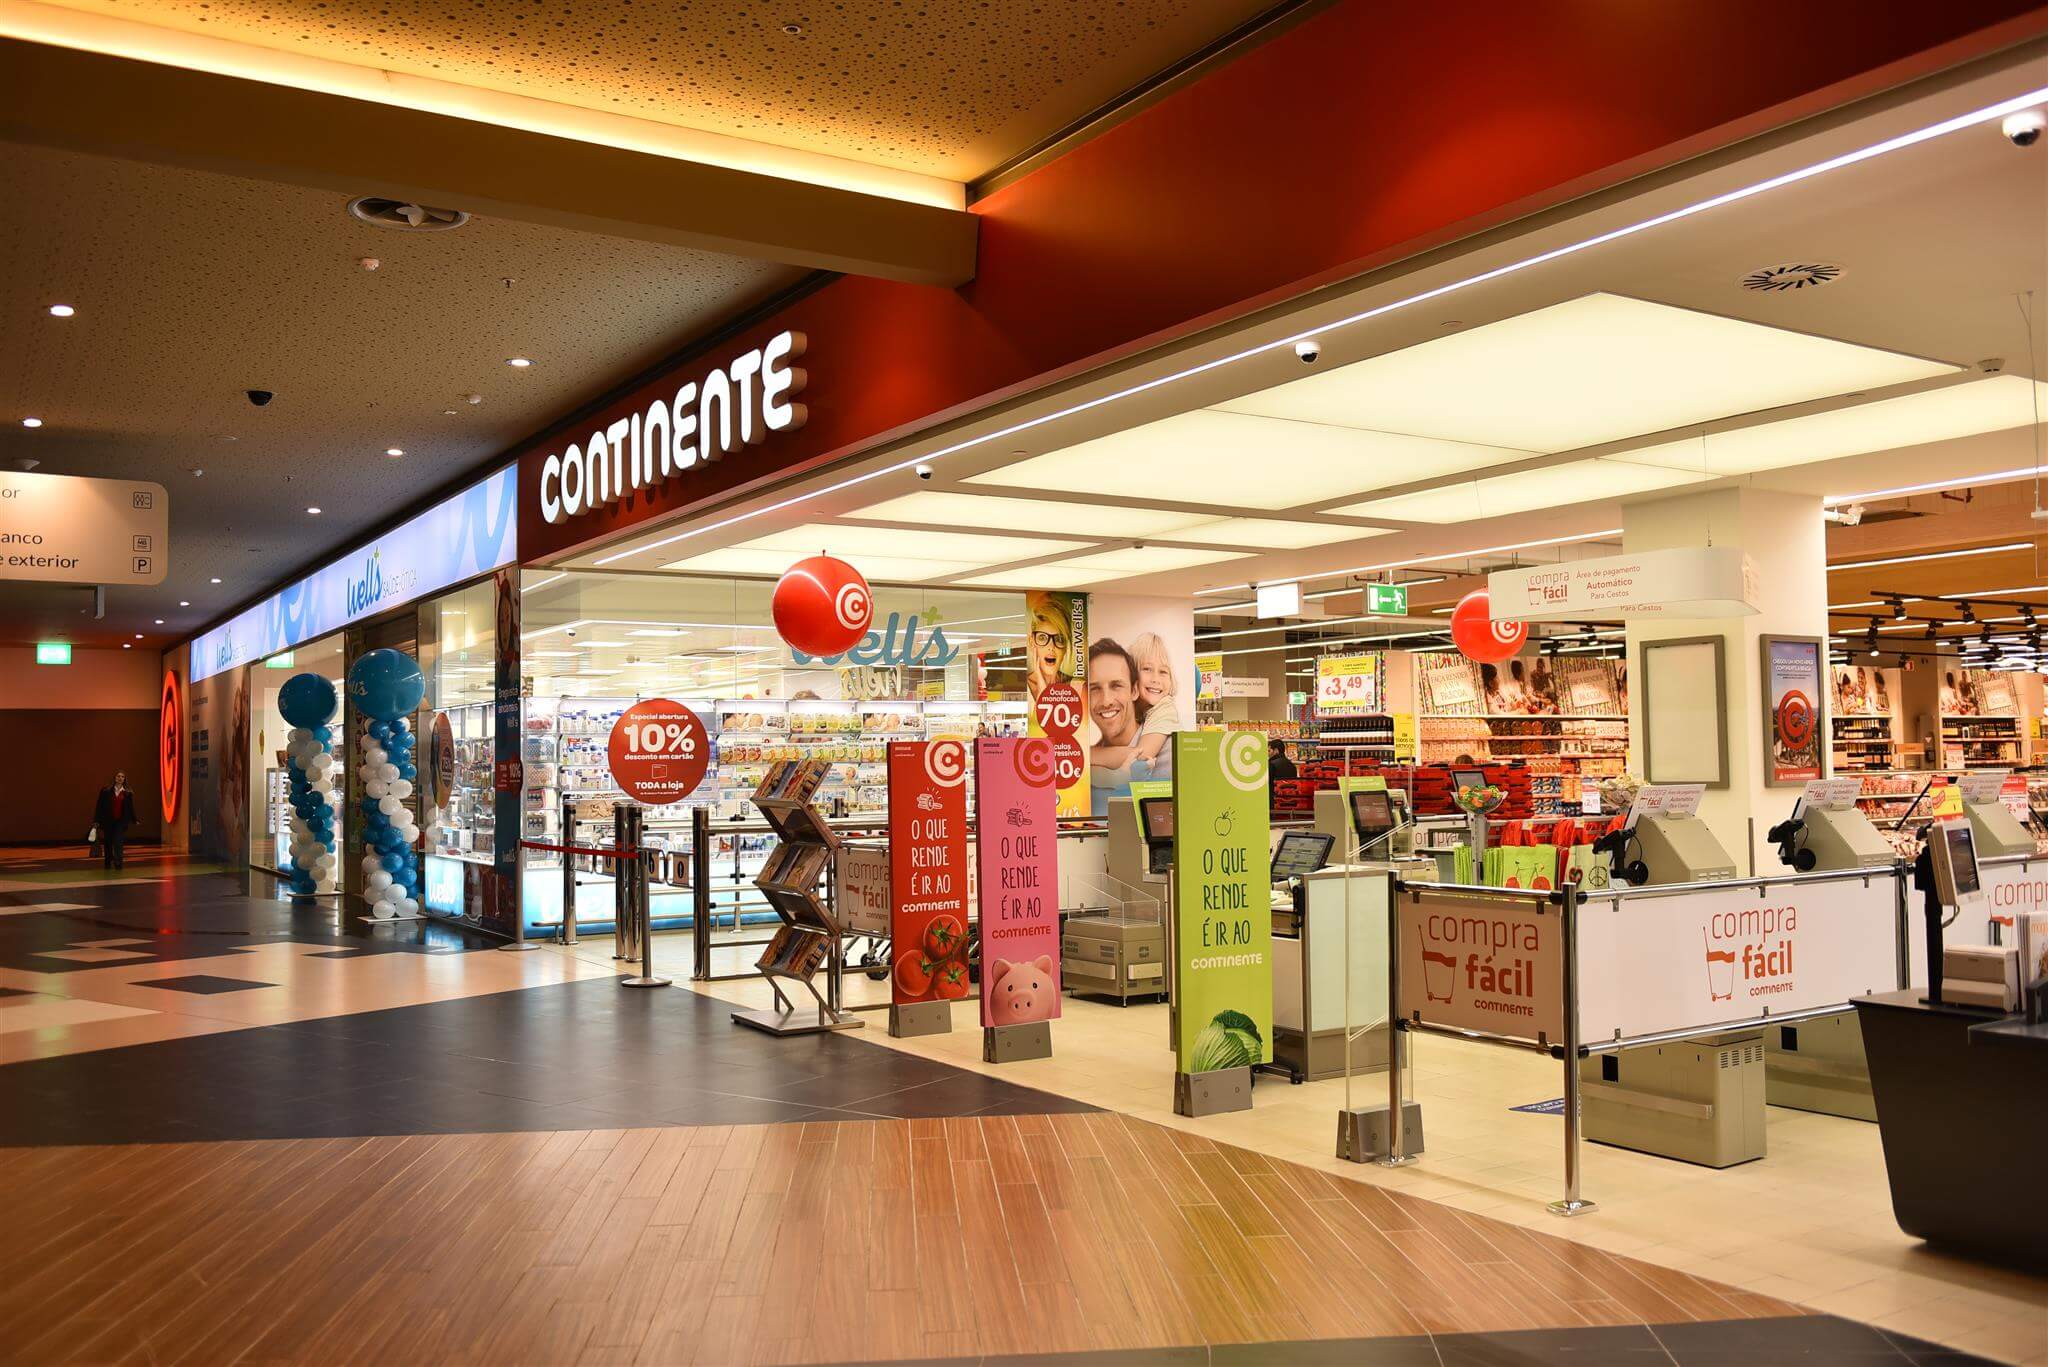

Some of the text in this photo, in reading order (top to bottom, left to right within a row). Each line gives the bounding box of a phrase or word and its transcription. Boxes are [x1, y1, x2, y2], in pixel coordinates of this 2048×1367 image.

[540, 330, 806, 523] CONTINENTE
[8, 554, 79, 569] exterior
[1603, 564, 1641, 577] pagamento
[1529, 571, 1569, 586] compra
[1586, 578, 1633, 590] Automático
[1543, 584, 1568, 599] fácil
[1050, 687, 1072, 696] Óculos
[1037, 703, 1080, 728] 70€
[623, 723, 696, 753] 10%
[635, 781, 660, 790] TODA
[667, 781, 684, 790] loja
[911, 818, 949, 841] O QUE
[911, 846, 949, 868] RENDE
[1001, 836, 1039, 860] O QUE
[848, 862, 889, 886] compra
[1203, 848, 1248, 876] O QUE
[911, 872, 918, 896] É
[922, 875, 932, 895] IR
[936, 874, 951, 895] AO
[1001, 866, 1040, 890] RENDE
[863, 885, 888, 909] fácil
[902, 899, 961, 913] CONTINENTE
[1001, 895, 1041, 921] É IR AO
[1203, 883, 1249, 911] RENDE
[991, 925, 1052, 940] CONTINENTE
[1203, 917, 1251, 947] É IR AO
[1712, 904, 1797, 942] compra
[1428, 914, 1539, 957] compra
[1191, 952, 1263, 970] CONTINENTE
[1741, 939, 1793, 980] fácil
[1465, 953, 1534, 998] fácil
[1749, 982, 1793, 998] CONTINENTE
[1474, 999, 1534, 1017] CONTINENTE
